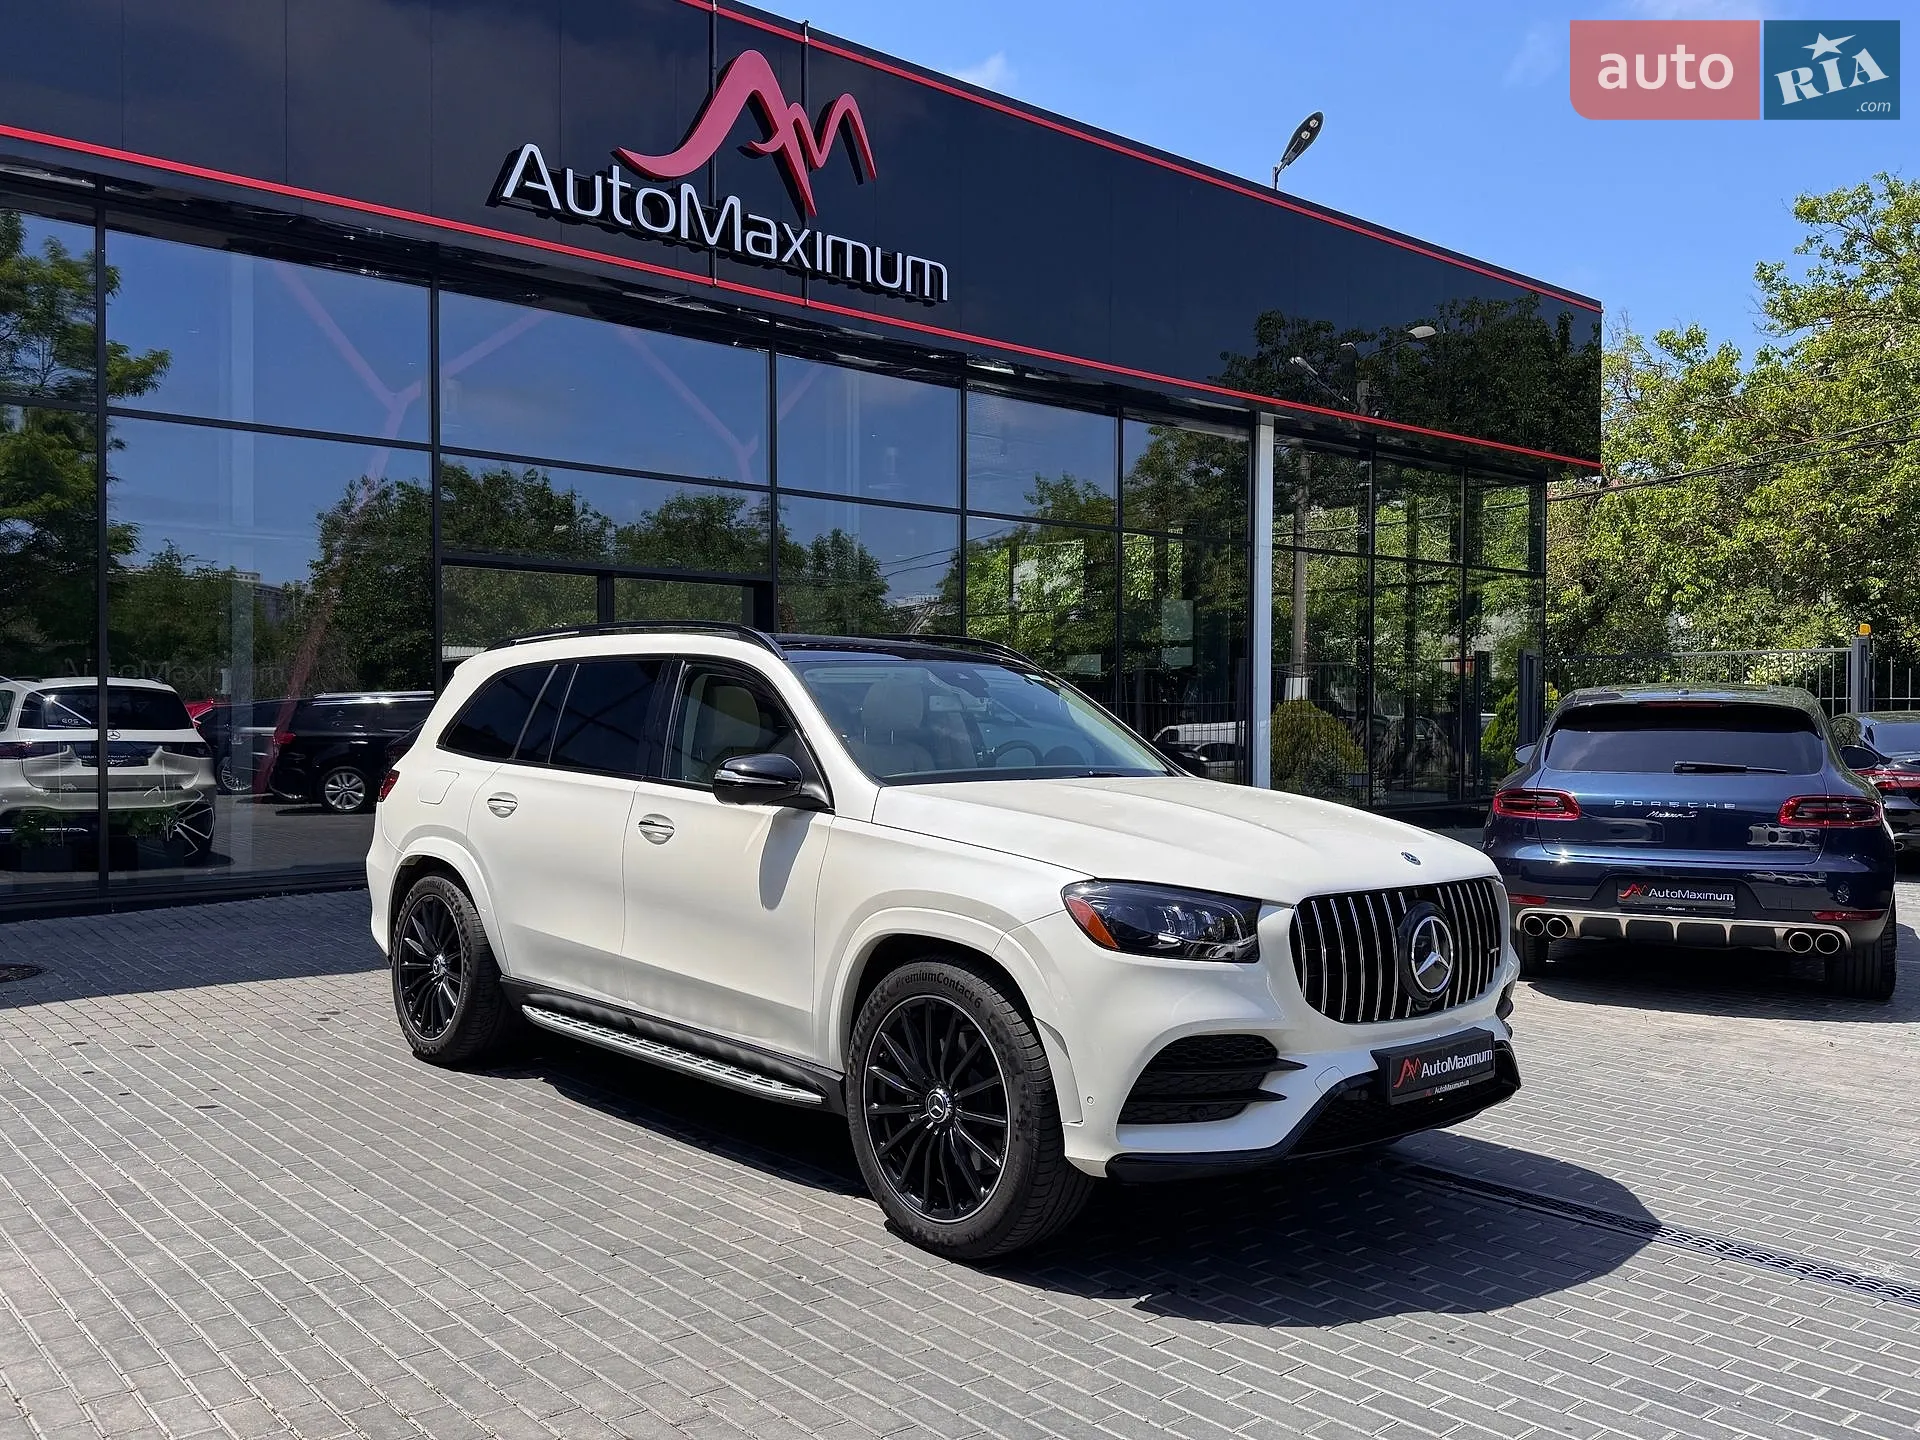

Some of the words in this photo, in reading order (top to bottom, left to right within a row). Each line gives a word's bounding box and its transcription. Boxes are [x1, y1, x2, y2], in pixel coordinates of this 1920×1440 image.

[501, 142, 949, 301] AutoMaximum
[1613, 799, 1736, 810] PORSCHE
[1648, 887, 1735, 902] AutoMaximum
[895, 970, 976, 1001] PremiumContact
[974, 997, 984, 1009] 6
[1420, 1048, 1493, 1078] AutoMaximum
